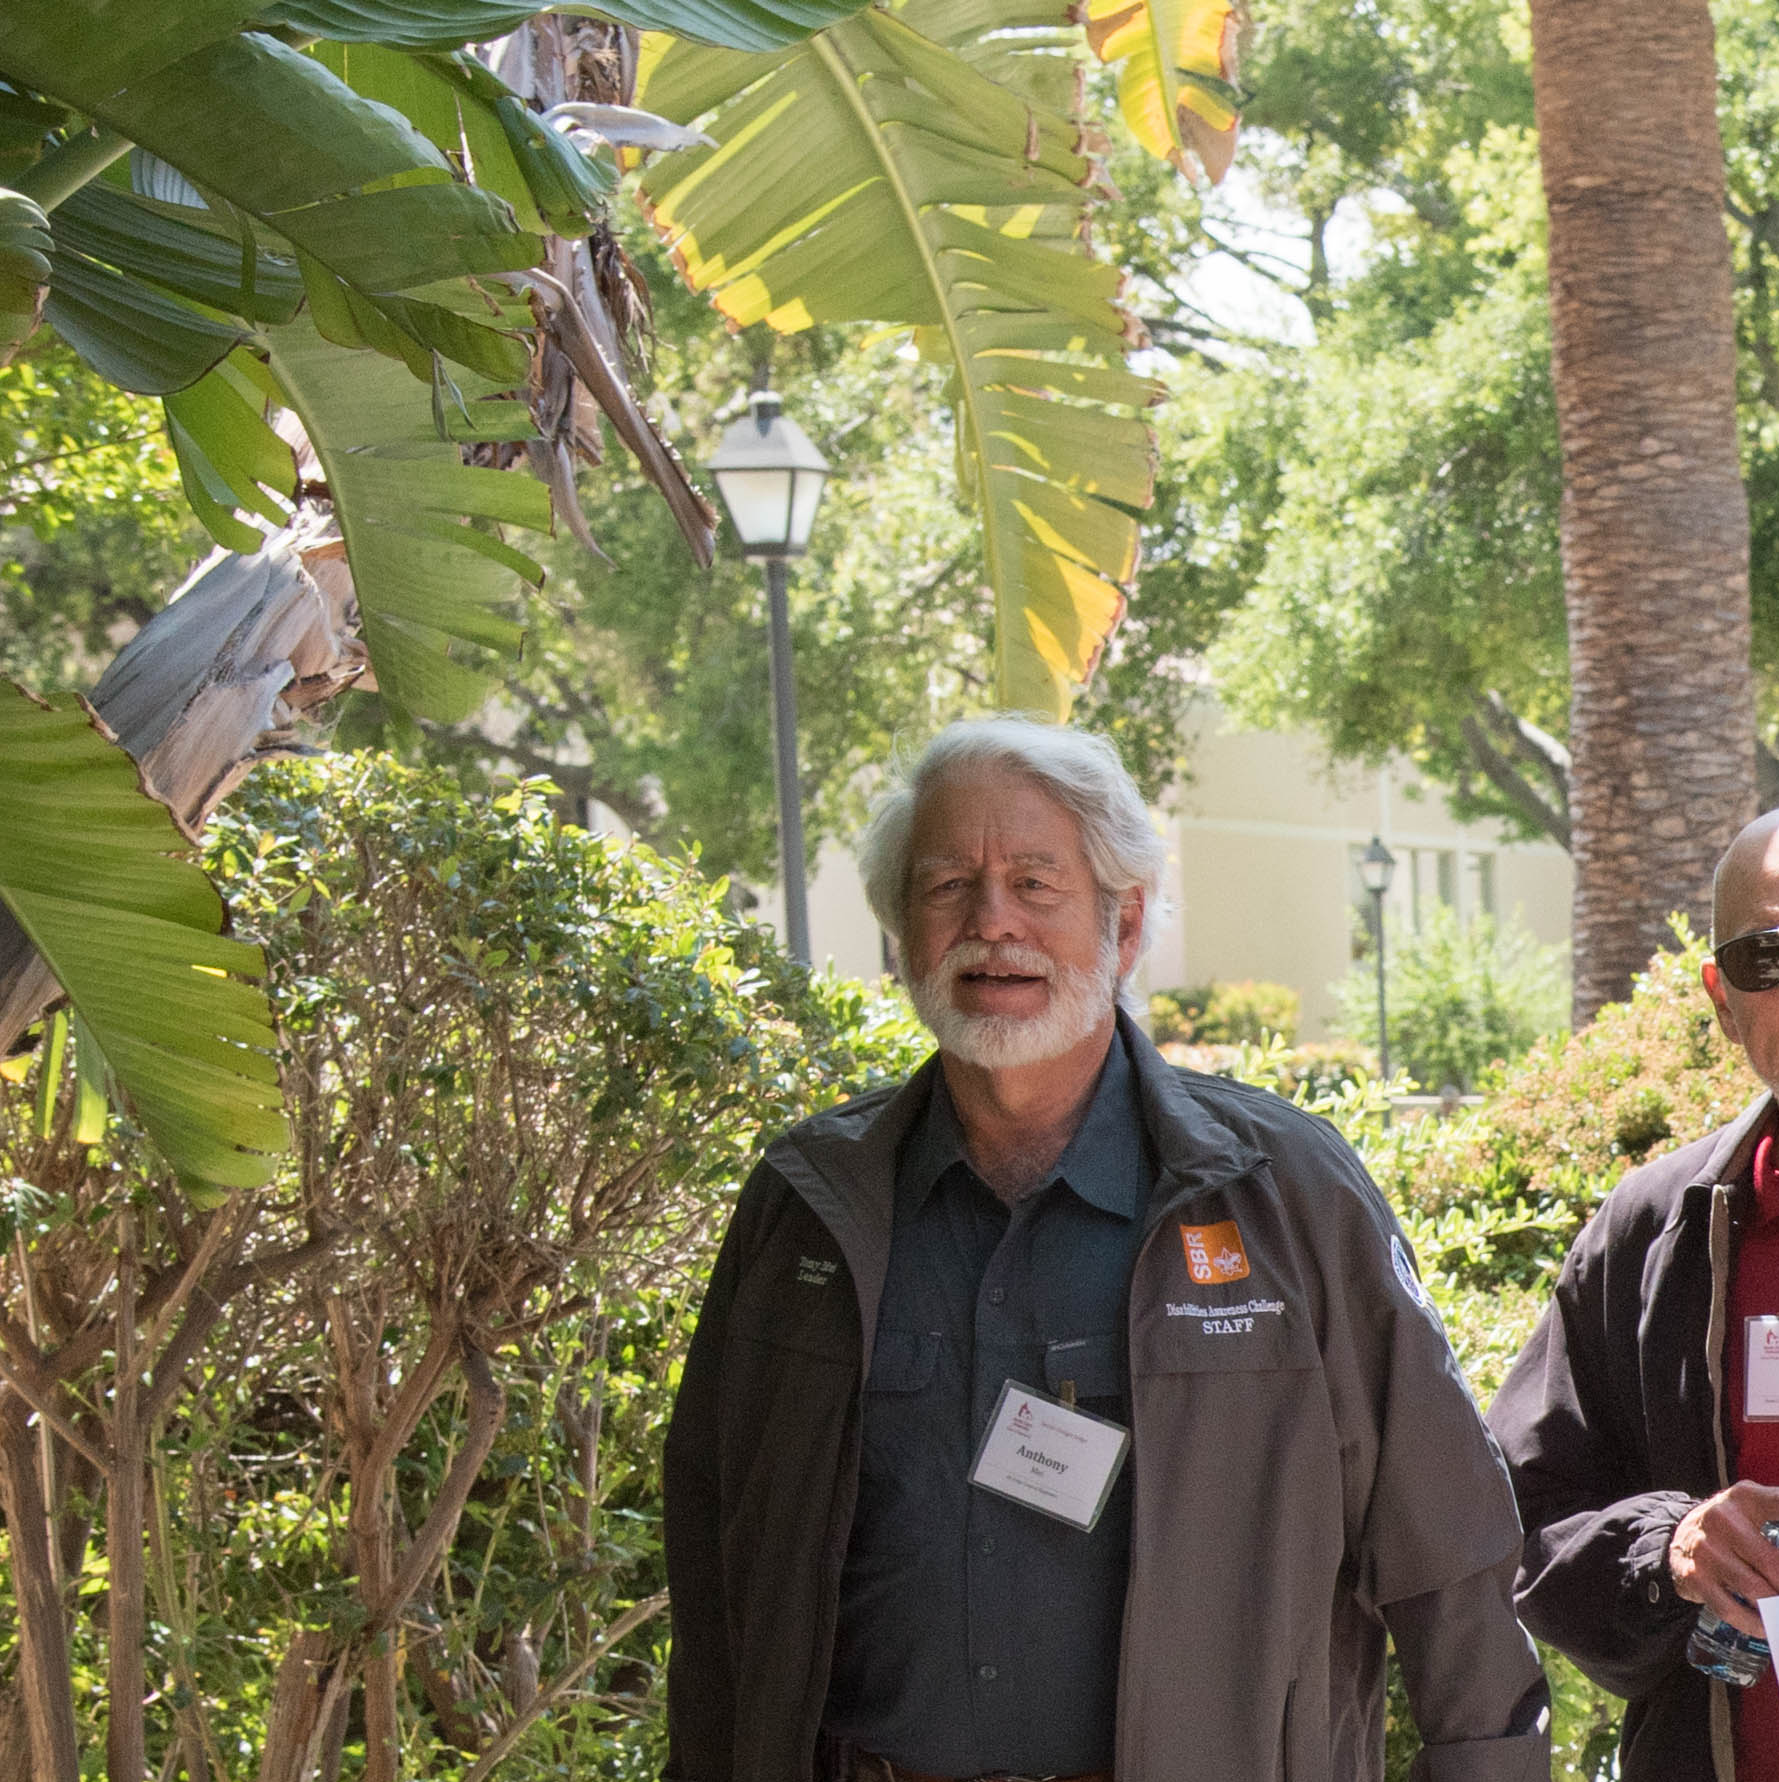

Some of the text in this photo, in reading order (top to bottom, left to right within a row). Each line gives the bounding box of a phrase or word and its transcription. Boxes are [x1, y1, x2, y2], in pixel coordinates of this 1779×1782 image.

[1184, 1231, 1212, 1280] SBR
[1208, 1304, 1248, 1317] Awareness
[1248, 1299, 1285, 1315] Challenge
[1202, 1317, 1254, 1334] STAFF
[1016, 1444, 1069, 1475] Anthony
